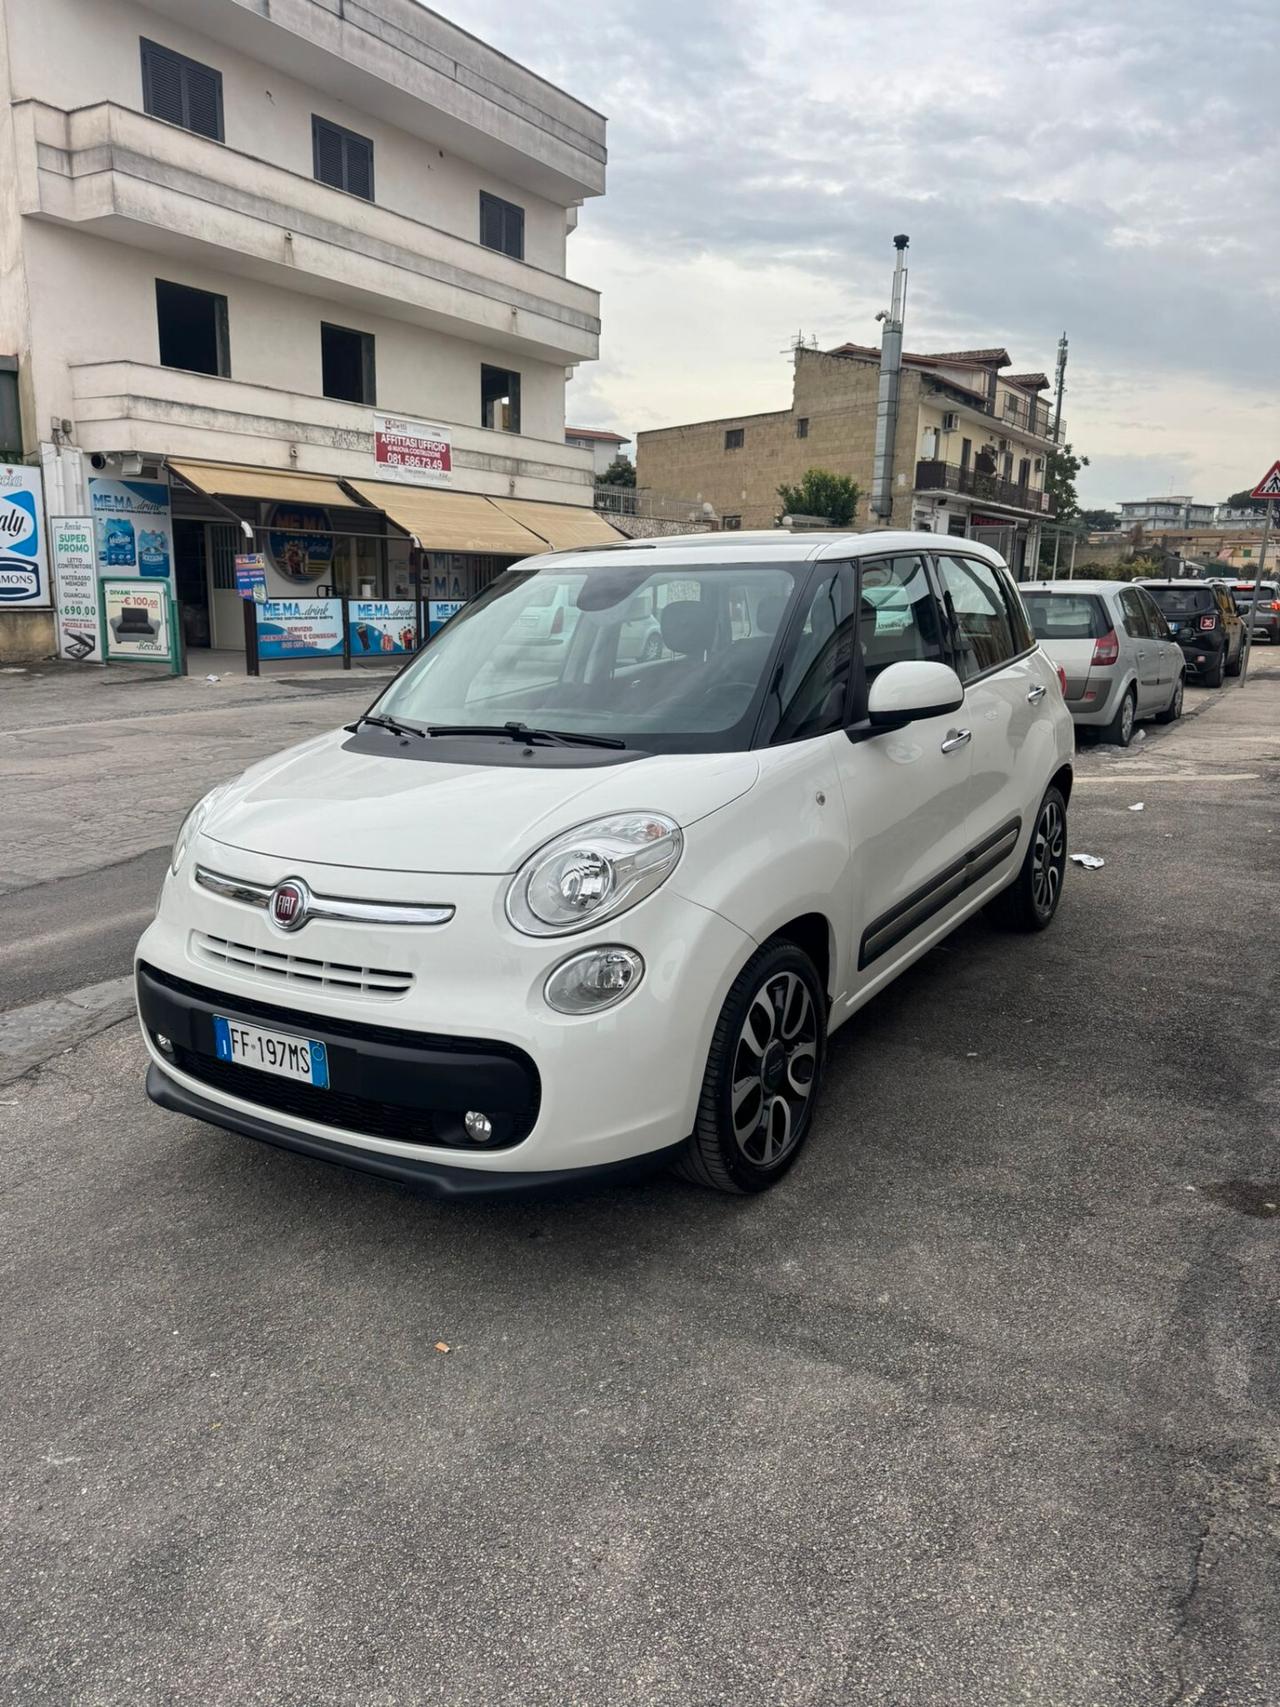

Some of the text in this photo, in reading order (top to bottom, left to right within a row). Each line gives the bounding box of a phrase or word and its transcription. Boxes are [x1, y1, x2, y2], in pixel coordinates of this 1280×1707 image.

[381, 434, 418, 449] AFFITTASI
[418, 440, 446, 453] UFFICIO
[59, 533, 87, 543] SUPER
[58, 543, 90, 553] PROMO
[0, 574, 34, 584] MONS
[277, 894, 297, 915] FIAT
